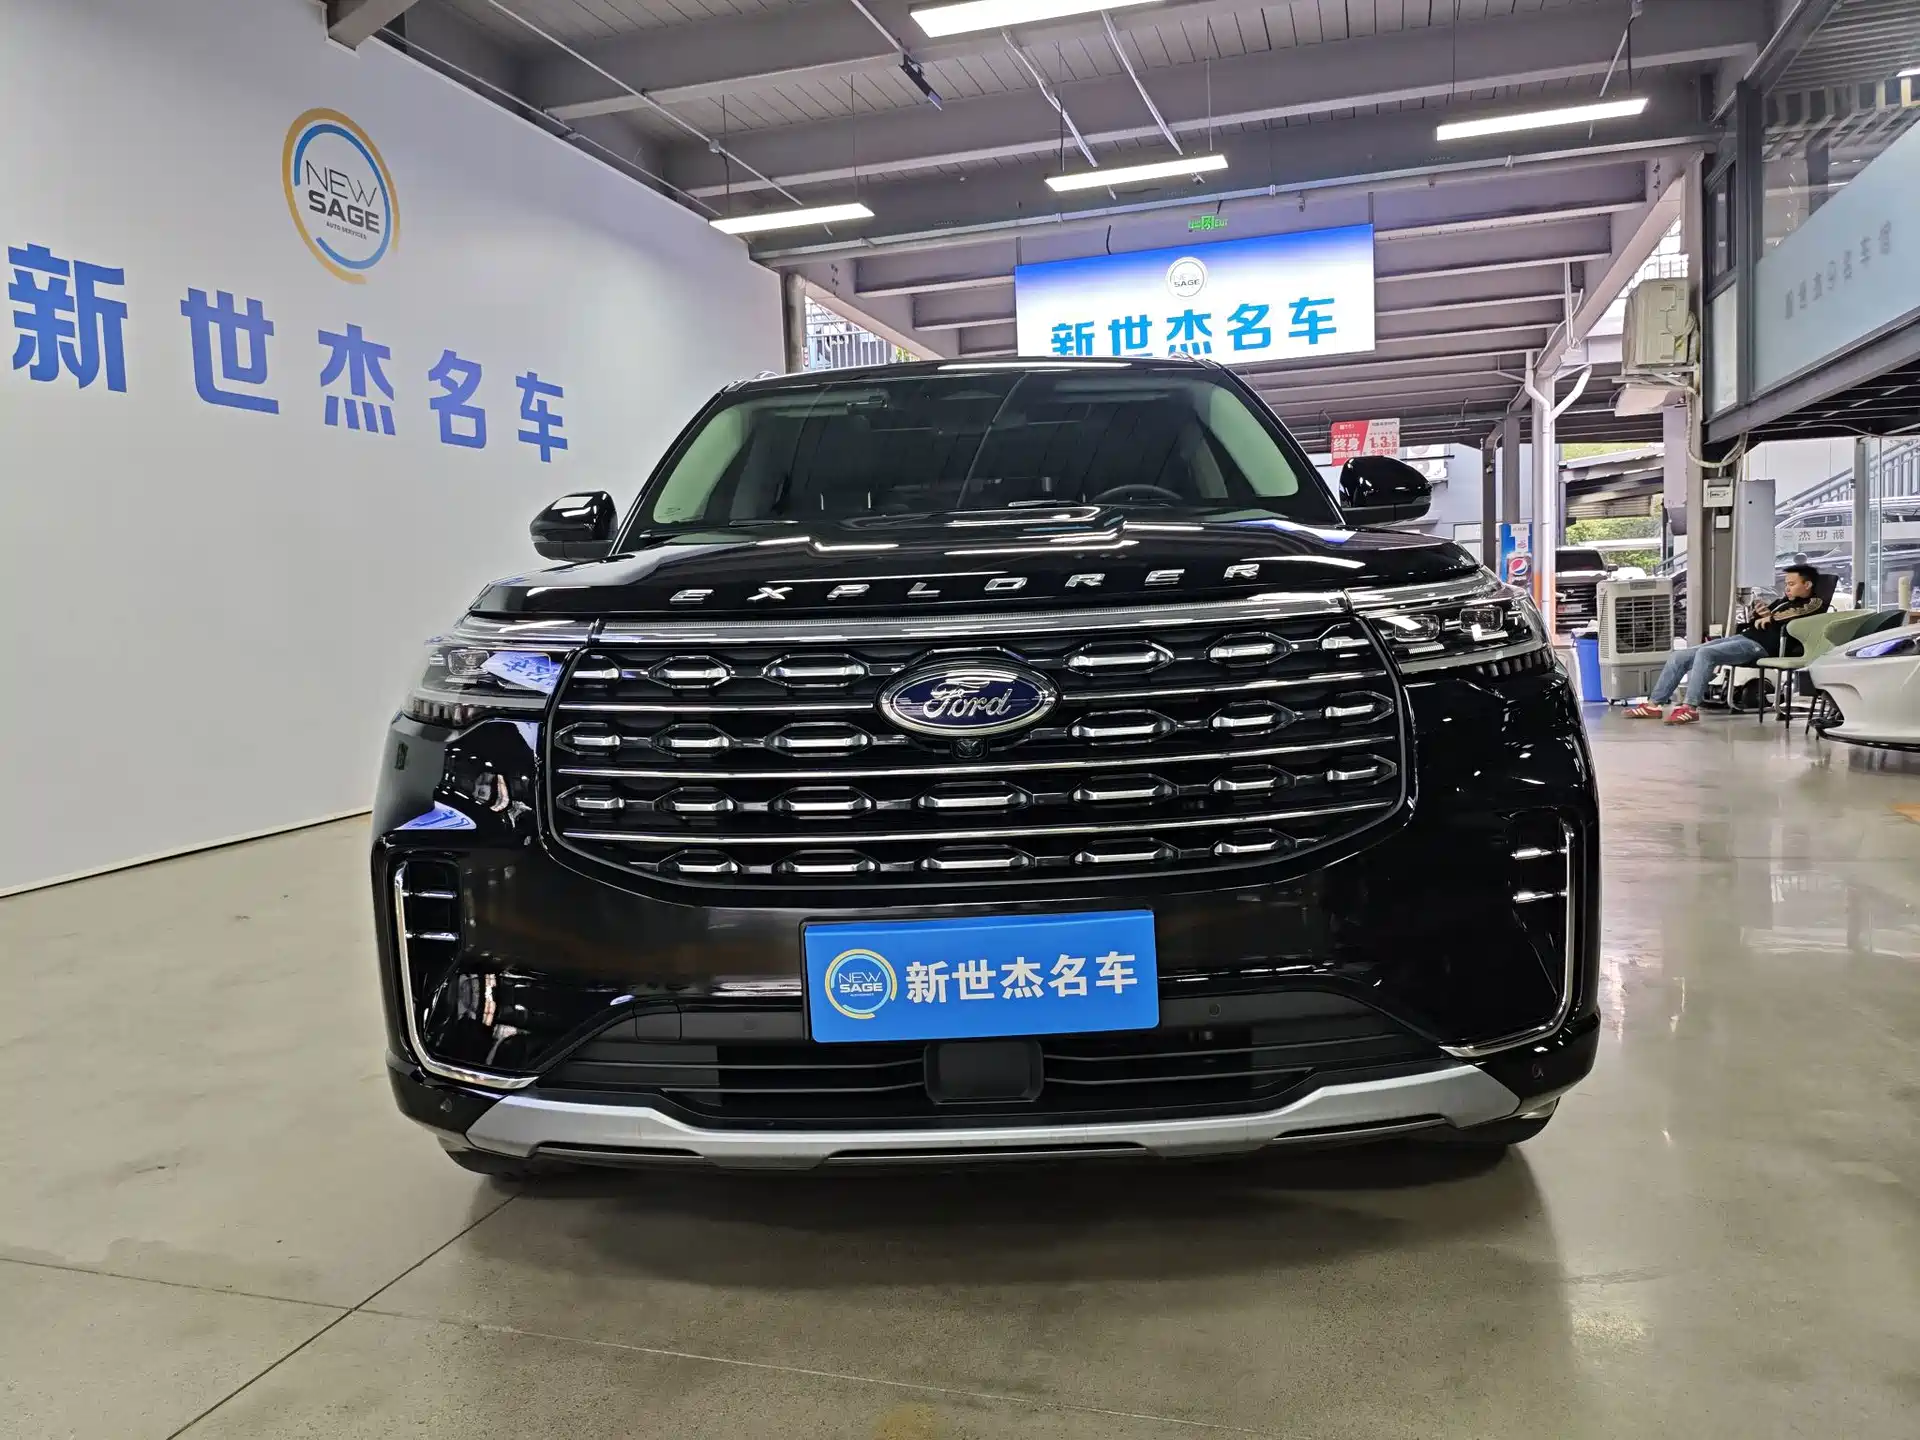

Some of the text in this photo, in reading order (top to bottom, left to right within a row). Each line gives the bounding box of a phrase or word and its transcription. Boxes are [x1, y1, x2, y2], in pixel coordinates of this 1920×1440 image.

[306, 160, 377, 207] NEW
[308, 189, 380, 234] SAGE
[1174, 279, 1200, 288] SAGE
[1050, 296, 1337, 357] 新世杰名车
[8, 243, 569, 463] 新世杰名车
[1333, 437, 1360, 451] 终身
[669, 562, 1261, 602] EXPLORER
[922, 681, 1013, 719] Ford
[838, 971, 882, 984] NEW
[839, 982, 884, 993] SAGE
[905, 951, 1138, 1004] 新世杰名车
